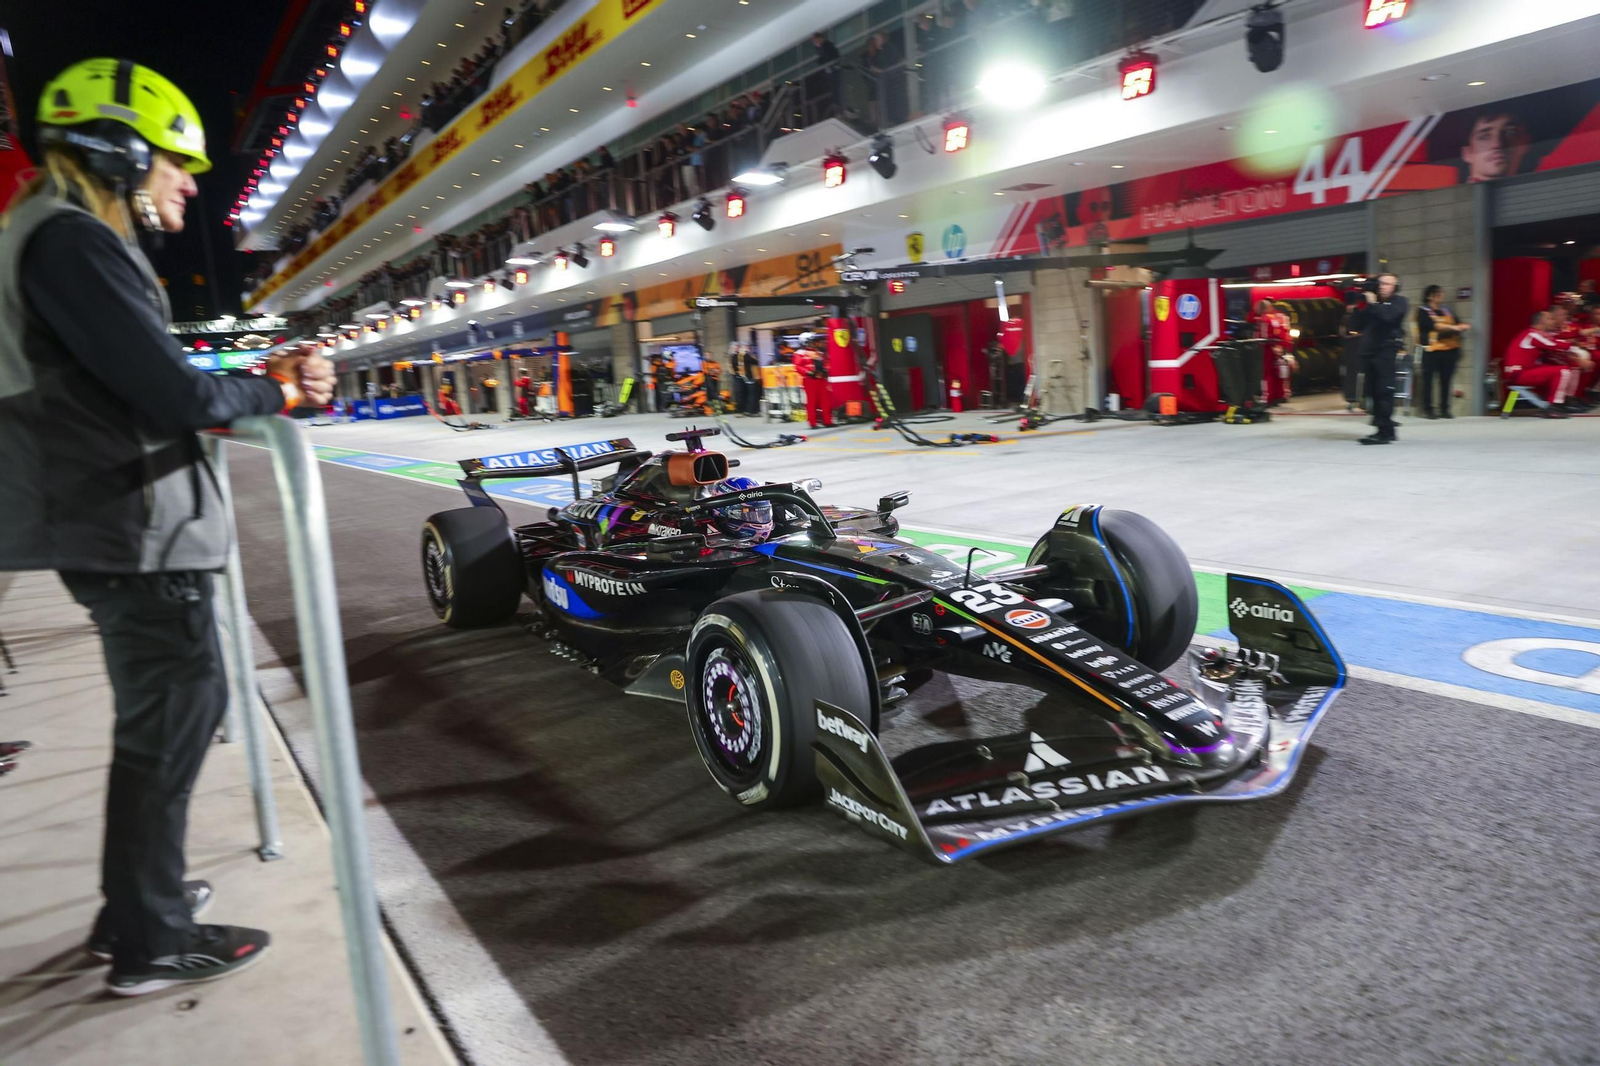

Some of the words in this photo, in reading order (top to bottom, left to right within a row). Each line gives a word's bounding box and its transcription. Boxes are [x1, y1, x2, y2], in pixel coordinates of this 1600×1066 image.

[1293, 136, 1370, 204] 44
[1140, 182, 1287, 229] HAMILTON
[655, 523, 682, 537] kraken
[574, 570, 648, 596] MYPROTEIN
[950, 582, 1025, 614] 23
[1011, 613, 1045, 626] Gulf
[1251, 602, 1294, 623] airia
[816, 708, 869, 753] betway
[926, 765, 1170, 815] ATLASSIAN
